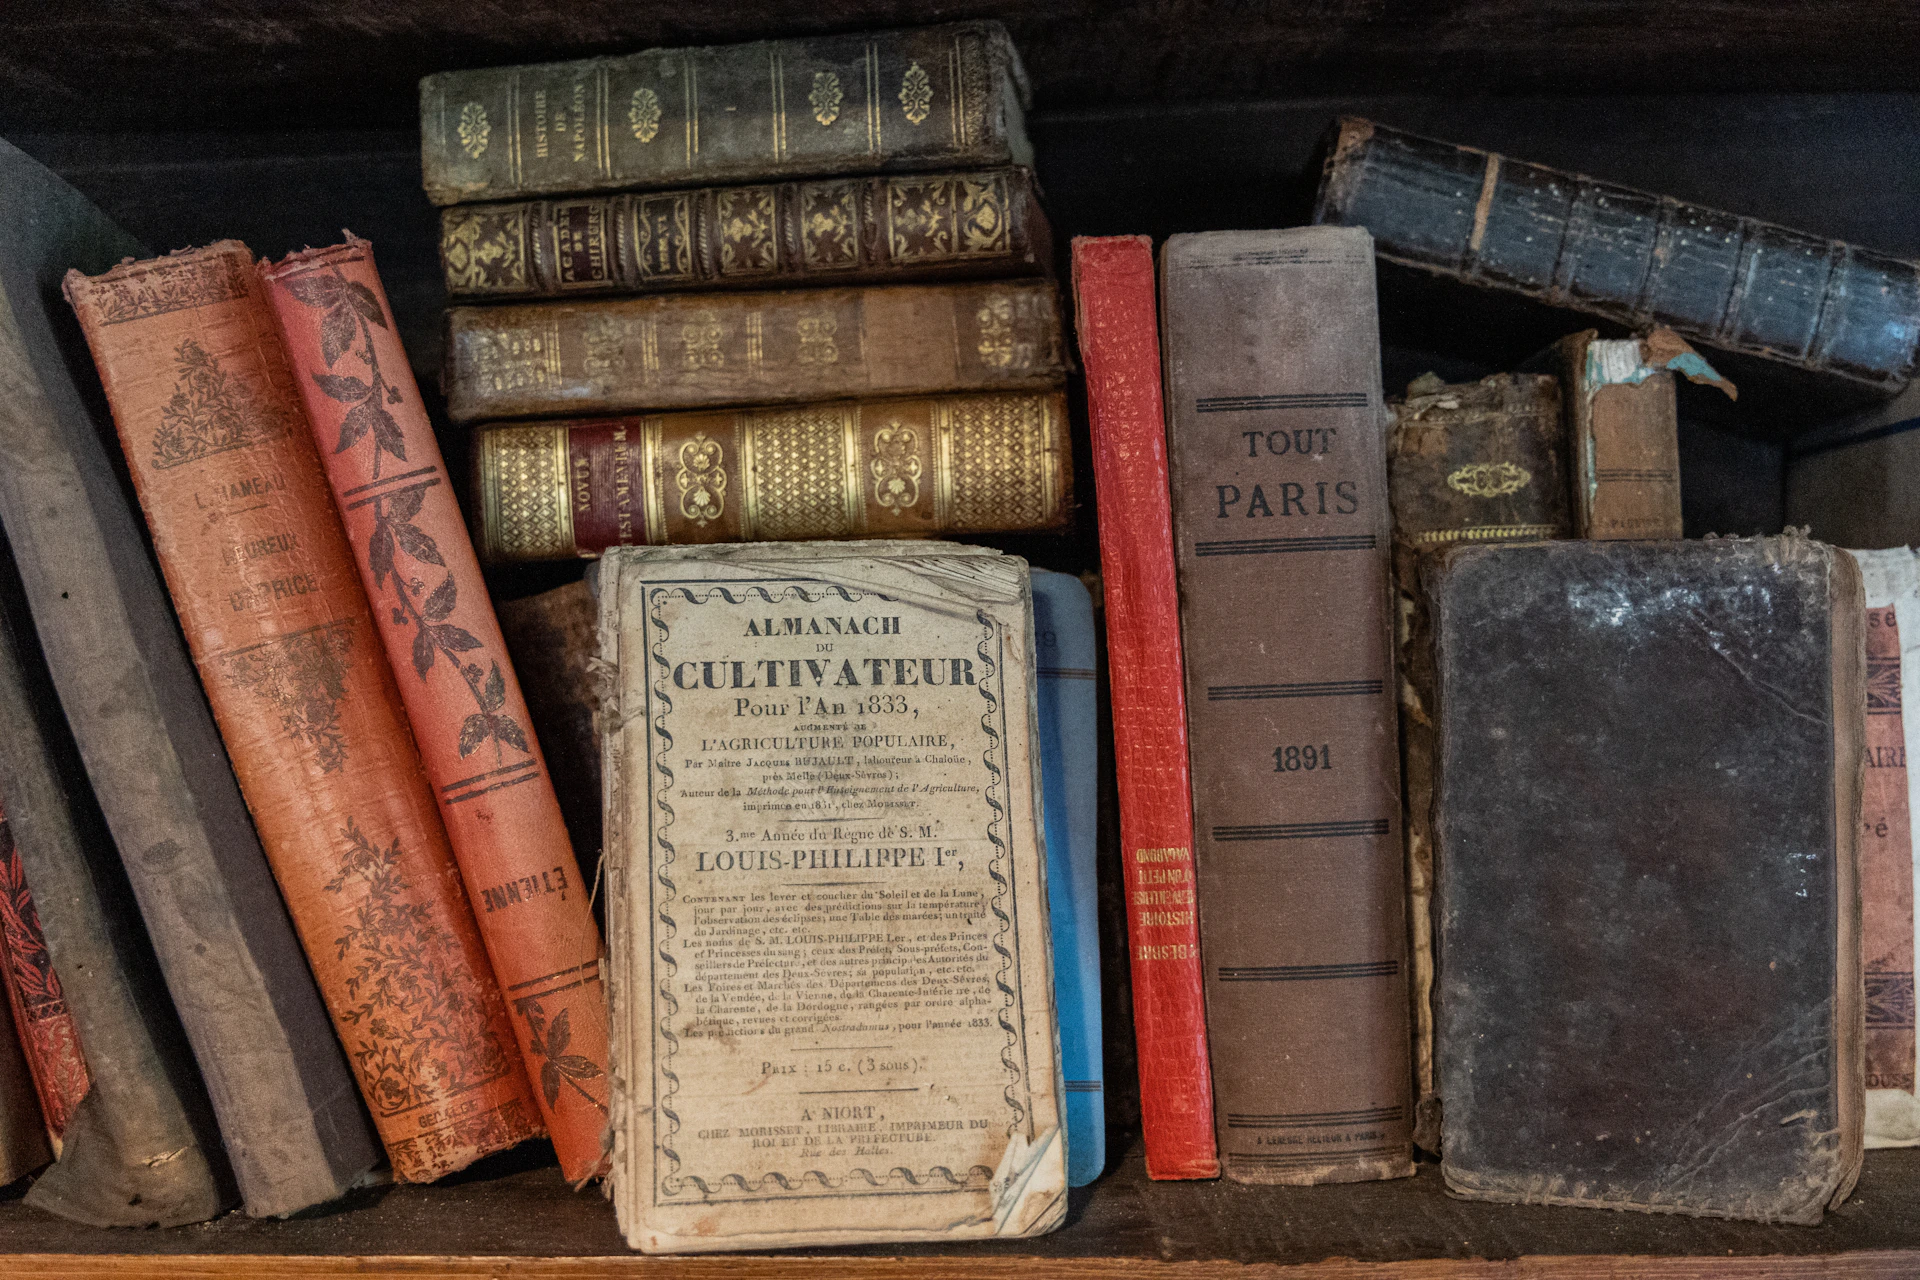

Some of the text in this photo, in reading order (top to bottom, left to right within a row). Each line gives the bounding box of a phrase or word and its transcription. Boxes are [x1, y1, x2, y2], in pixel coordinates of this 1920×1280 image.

[1242, 427, 1337, 458] TOUT
[1215, 480, 1359, 519] PARIS
[743, 616, 902, 637] ALMANACH
[816, 643, 834, 653] DU
[673, 657, 978, 690] CULTIVATEUR
[733, 694, 920, 719] Pour l'An 1833,
[701, 734, 955, 752] L'AGRICULTURE POPULAIRE,
[684, 759, 704, 768] Par
[1271, 743, 1333, 773] 1891
[680, 788, 715, 798] Auteur
[717, 788, 730, 797] de
[732, 787, 742, 797] la
[745, 787, 790, 797] Méthode
[791, 788, 816, 798] pour
[897, 783, 909, 793] de
[795, 802, 807, 810] en
[760, 828, 805, 842] Année
[809, 827, 828, 841] du
[832, 826, 874, 844] Règne
[899, 825, 914, 839] S.
[918, 825, 938, 839] M.
[695, 847, 925, 872] LOUIS-PHILIPPE
[1135, 847, 1191, 864] VAGABOND
[750, 893, 766, 902] les
[770, 892, 797, 902] lever
[816, 889, 858, 901] coucher
[861, 890, 874, 900] du
[879, 889, 909, 900] Soleil
[923, 889, 936, 899] de
[951, 888, 985, 899] Lune,
[694, 905, 715, 917] jour
[720, 906, 737, 917] par
[774, 904, 799, 913] avec
[804, 902, 822, 912] des
[826, 901, 883, 914] prédictions
[886, 902, 903, 911] sur
[693, 915, 761, 926] l'observation
[763, 914, 780, 923] des
[850, 912, 880, 922] Table
[882, 911, 900, 921] des
[1139, 911, 1194, 927] HISTOIRE
[694, 925, 811, 938] du Jardinage, etc. etc.
[683, 931, 988, 949] Les noms LOUIS-PHILIPPE des Princes
[707, 949, 761, 959] Princesses
[763, 947, 776, 956] du
[811, 947, 835, 956] ceux
[840, 957, 870, 967] autres
[928, 954, 974, 965] Autorités
[694, 970, 759, 984] département
[762, 969, 780, 980] des
[684, 983, 703, 993] Les
[708, 982, 741, 993] Foires
[806, 979, 824, 989] des
[901, 977, 918, 987] des
[722, 992, 765, 1003] Vendée,
[858, 1000, 899, 1013] rangées
[904, 1000, 921, 1011] par
[742, 1015, 777, 1025] revues
[768, 1024, 782, 1036] du
[784, 1023, 815, 1037] grand
[898, 1021, 923, 1033] pour
[926, 1019, 962, 1030] l'année
[817, 1059, 832, 1073] 15
[801, 1105, 885, 1121] A NIORT,
[697, 1128, 731, 1140] CHEZ
[969, 1118, 989, 1130] DU
